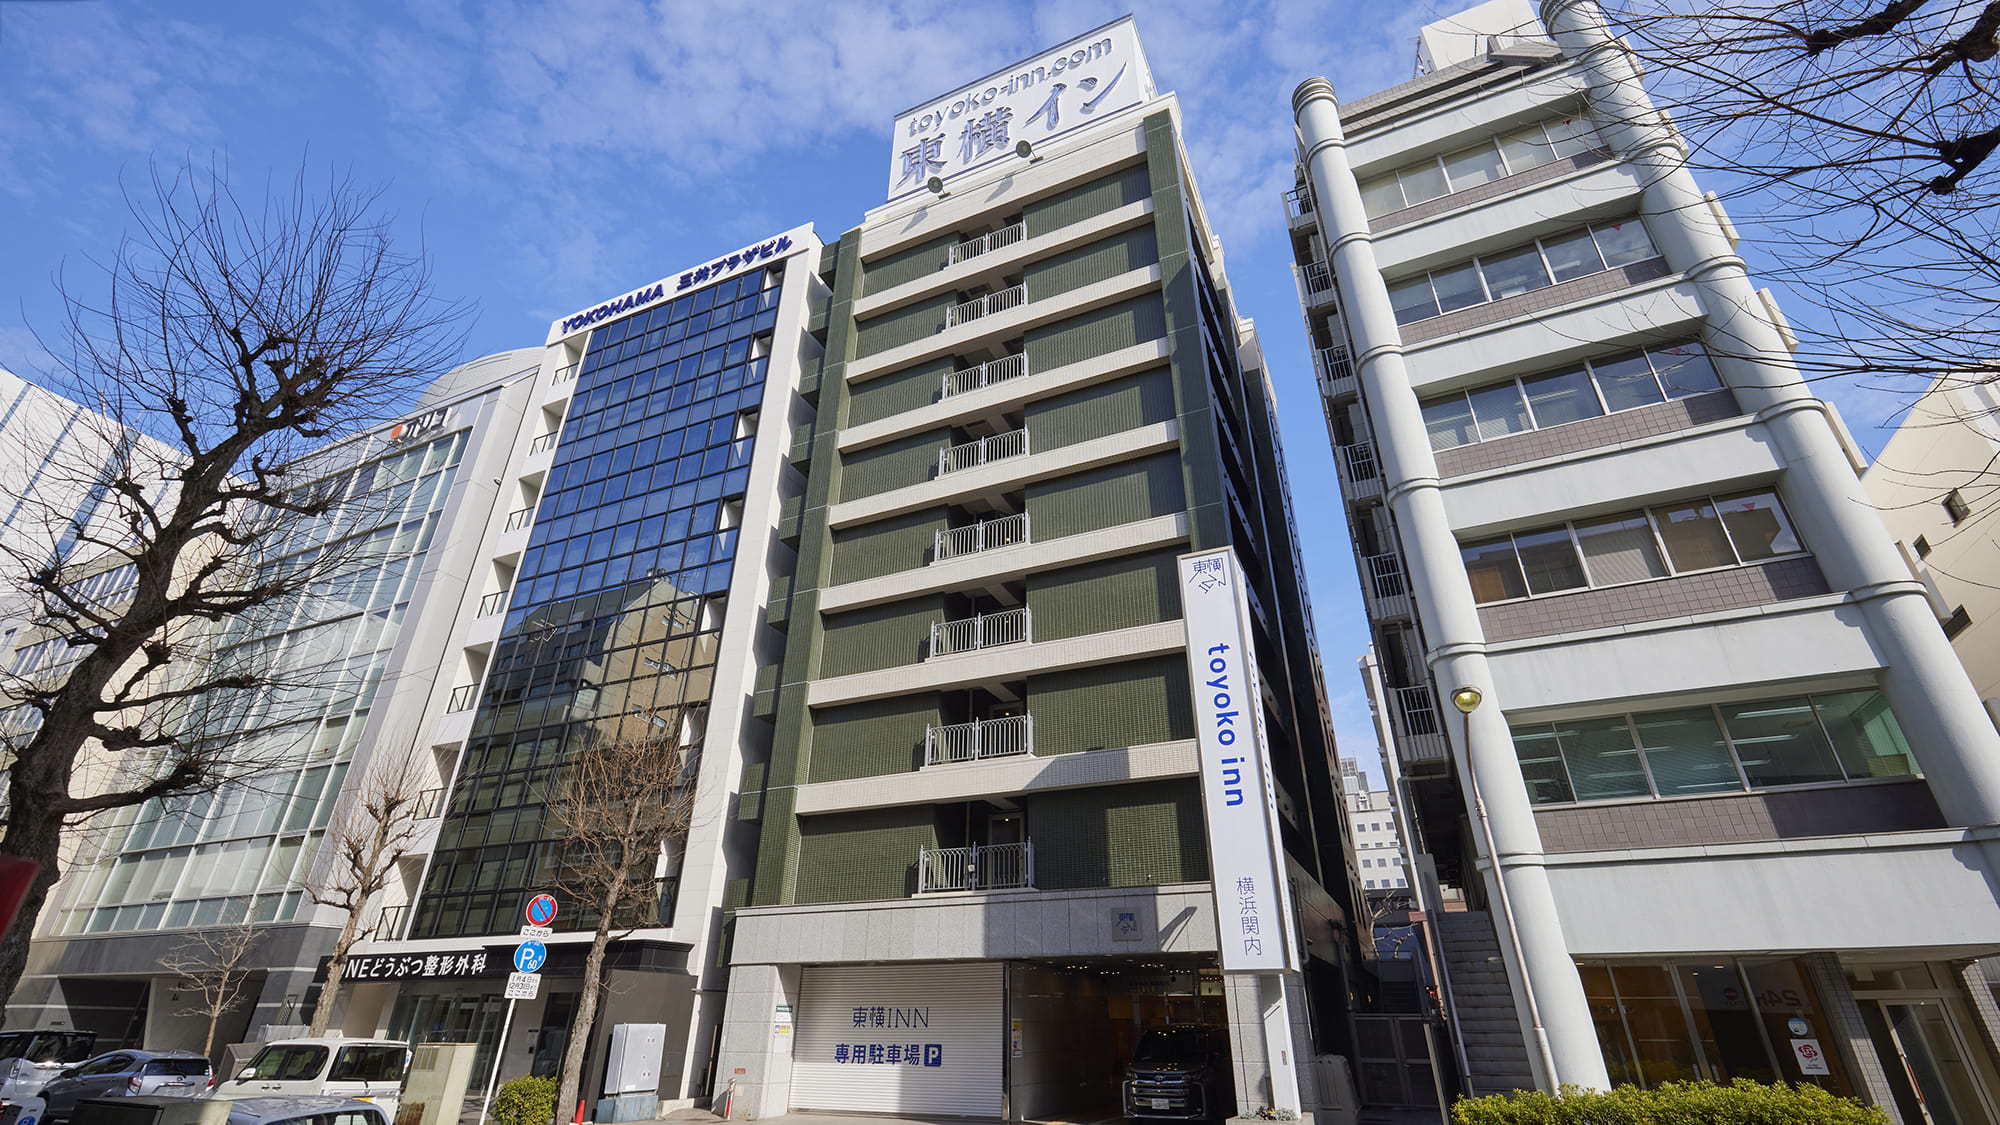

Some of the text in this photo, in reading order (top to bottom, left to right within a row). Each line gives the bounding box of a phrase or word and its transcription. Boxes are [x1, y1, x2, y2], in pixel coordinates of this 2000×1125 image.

[907, 37, 1113, 137] toyoko-inn.com
[896, 61, 1127, 188] 東横イン
[561, 284, 664, 334] YOKOHAMA
[1206, 642, 1246, 808] toyoko inn
[1235, 876, 1263, 957] 横浜関内
[341, 953, 488, 979] NEどうぶつ整形外科
[519, 947, 534, 969] P
[852, 1006, 929, 1029] 東横INN
[834, 1043, 921, 1066] 専用駐車場
